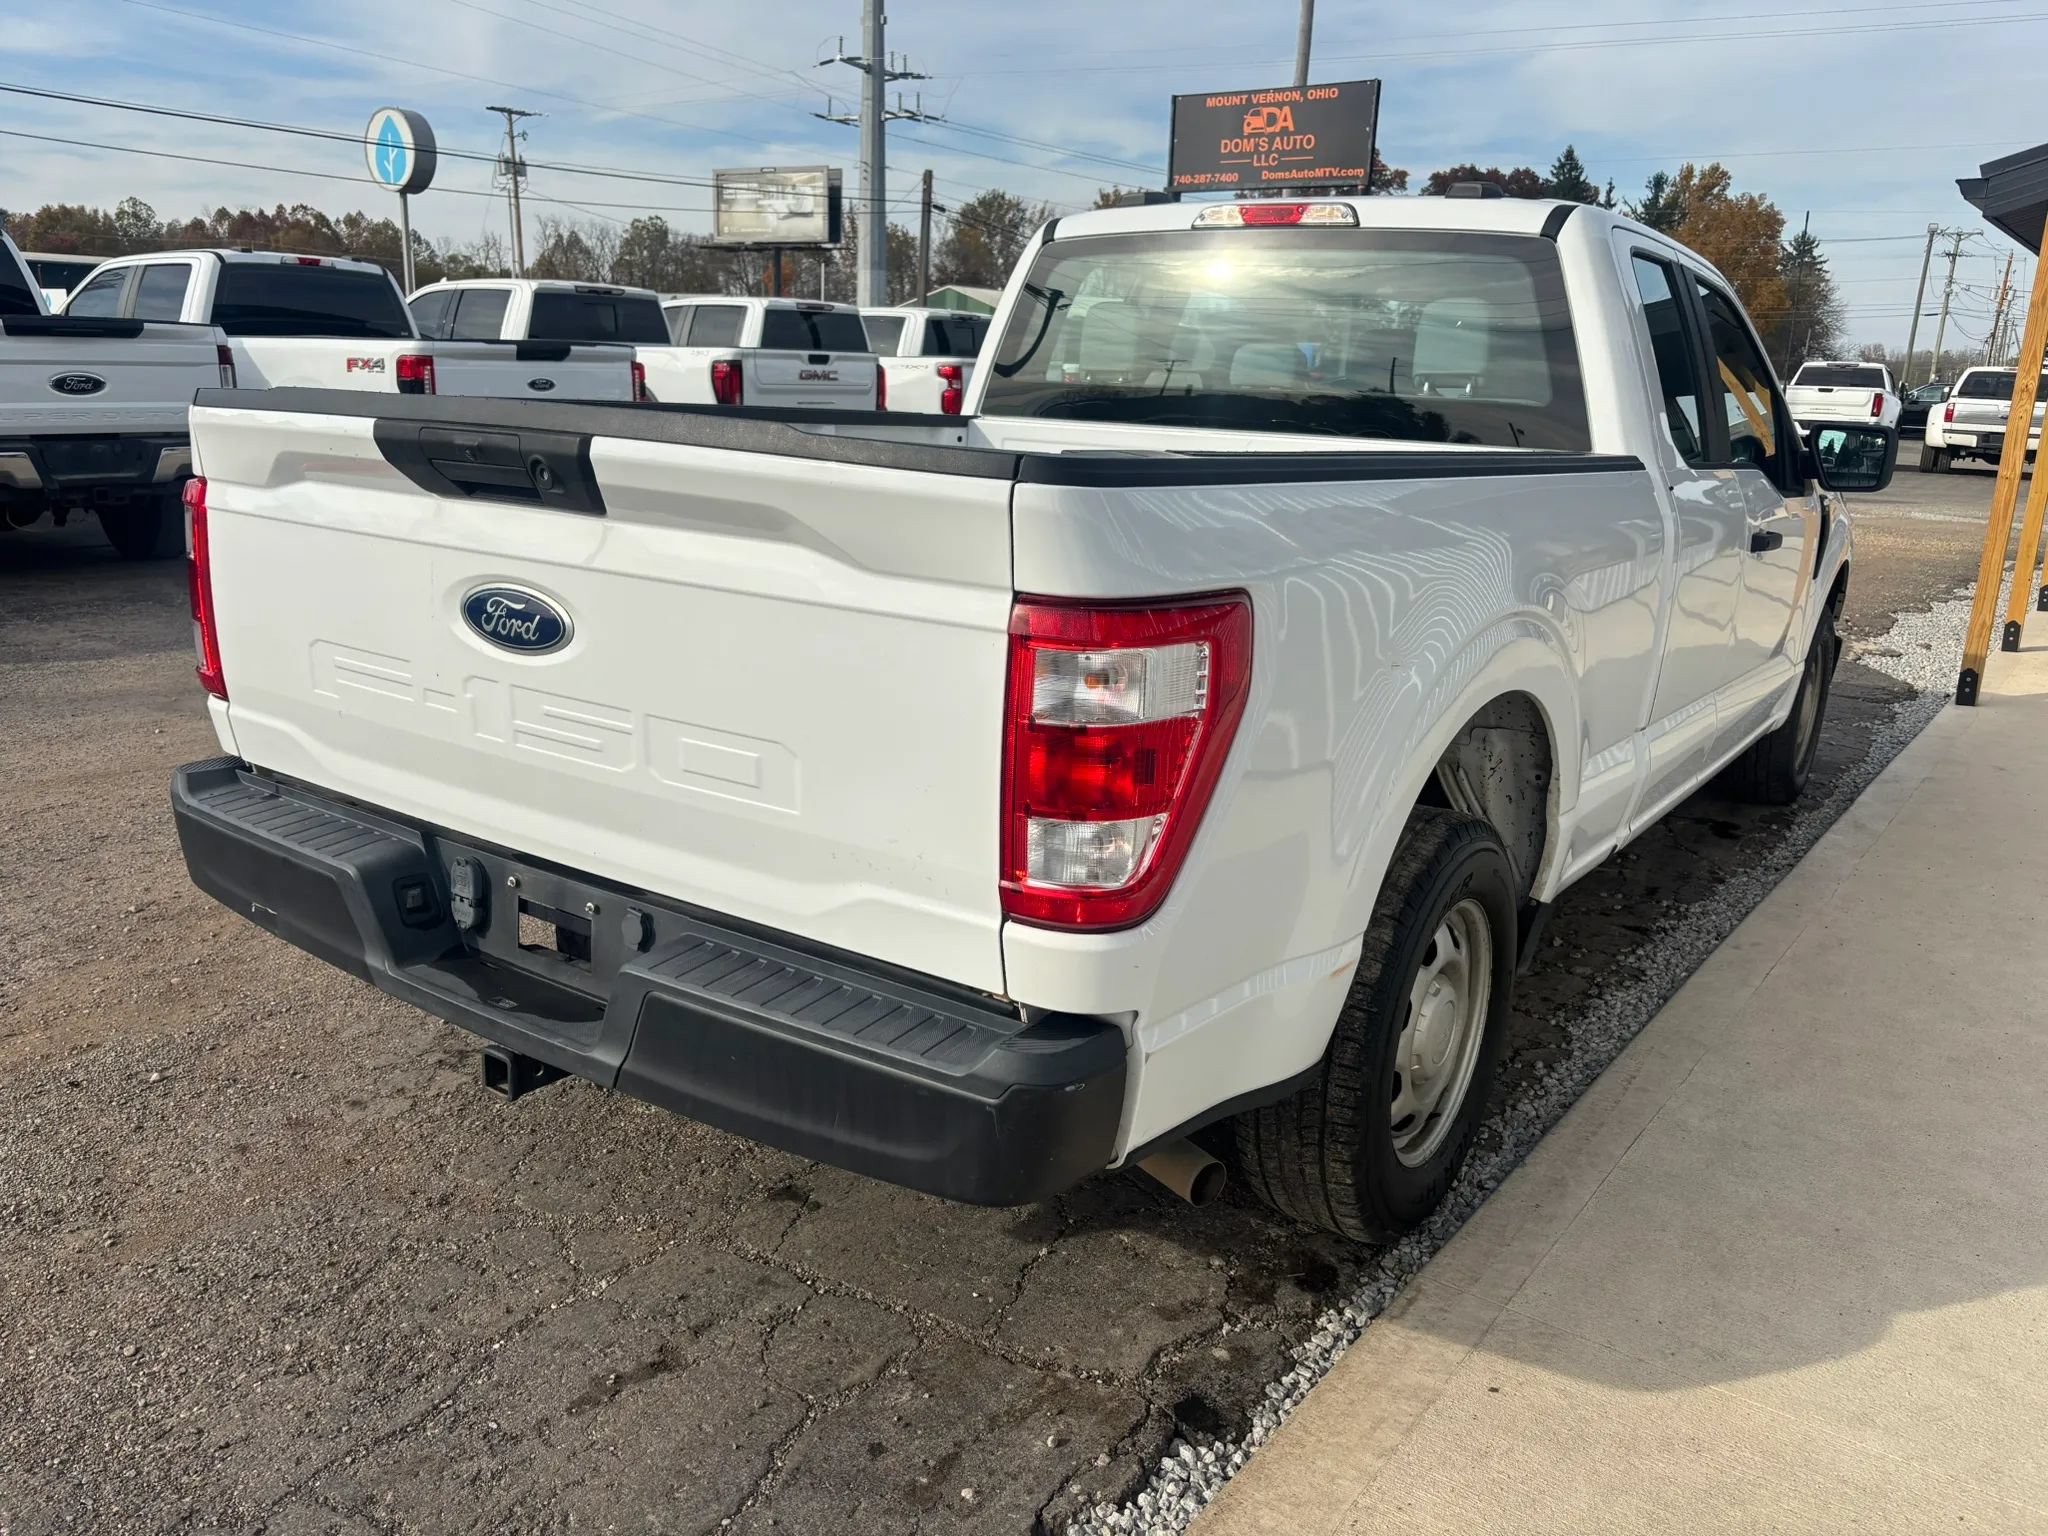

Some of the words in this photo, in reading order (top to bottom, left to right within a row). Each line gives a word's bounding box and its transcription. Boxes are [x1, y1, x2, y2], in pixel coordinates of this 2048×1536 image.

[1206, 95, 1249, 108] MOUNT
[1250, 91, 1304, 104] VERNON,
[1308, 87, 1339, 100] OHIO
[1220, 138, 1268, 153] DOM'S
[1272, 134, 1316, 150] AUTO
[1253, 153, 1279, 167] LLC
[1173, 173, 1239, 186] 740-287-7400
[1261, 167, 1364, 180] DomsAutoMTV.com
[347, 357, 386, 373] FX4
[799, 369, 839, 382] GMC
[64, 377, 94, 390] Ford
[481, 596, 540, 642] Ford
[309, 638, 801, 816] F-150
